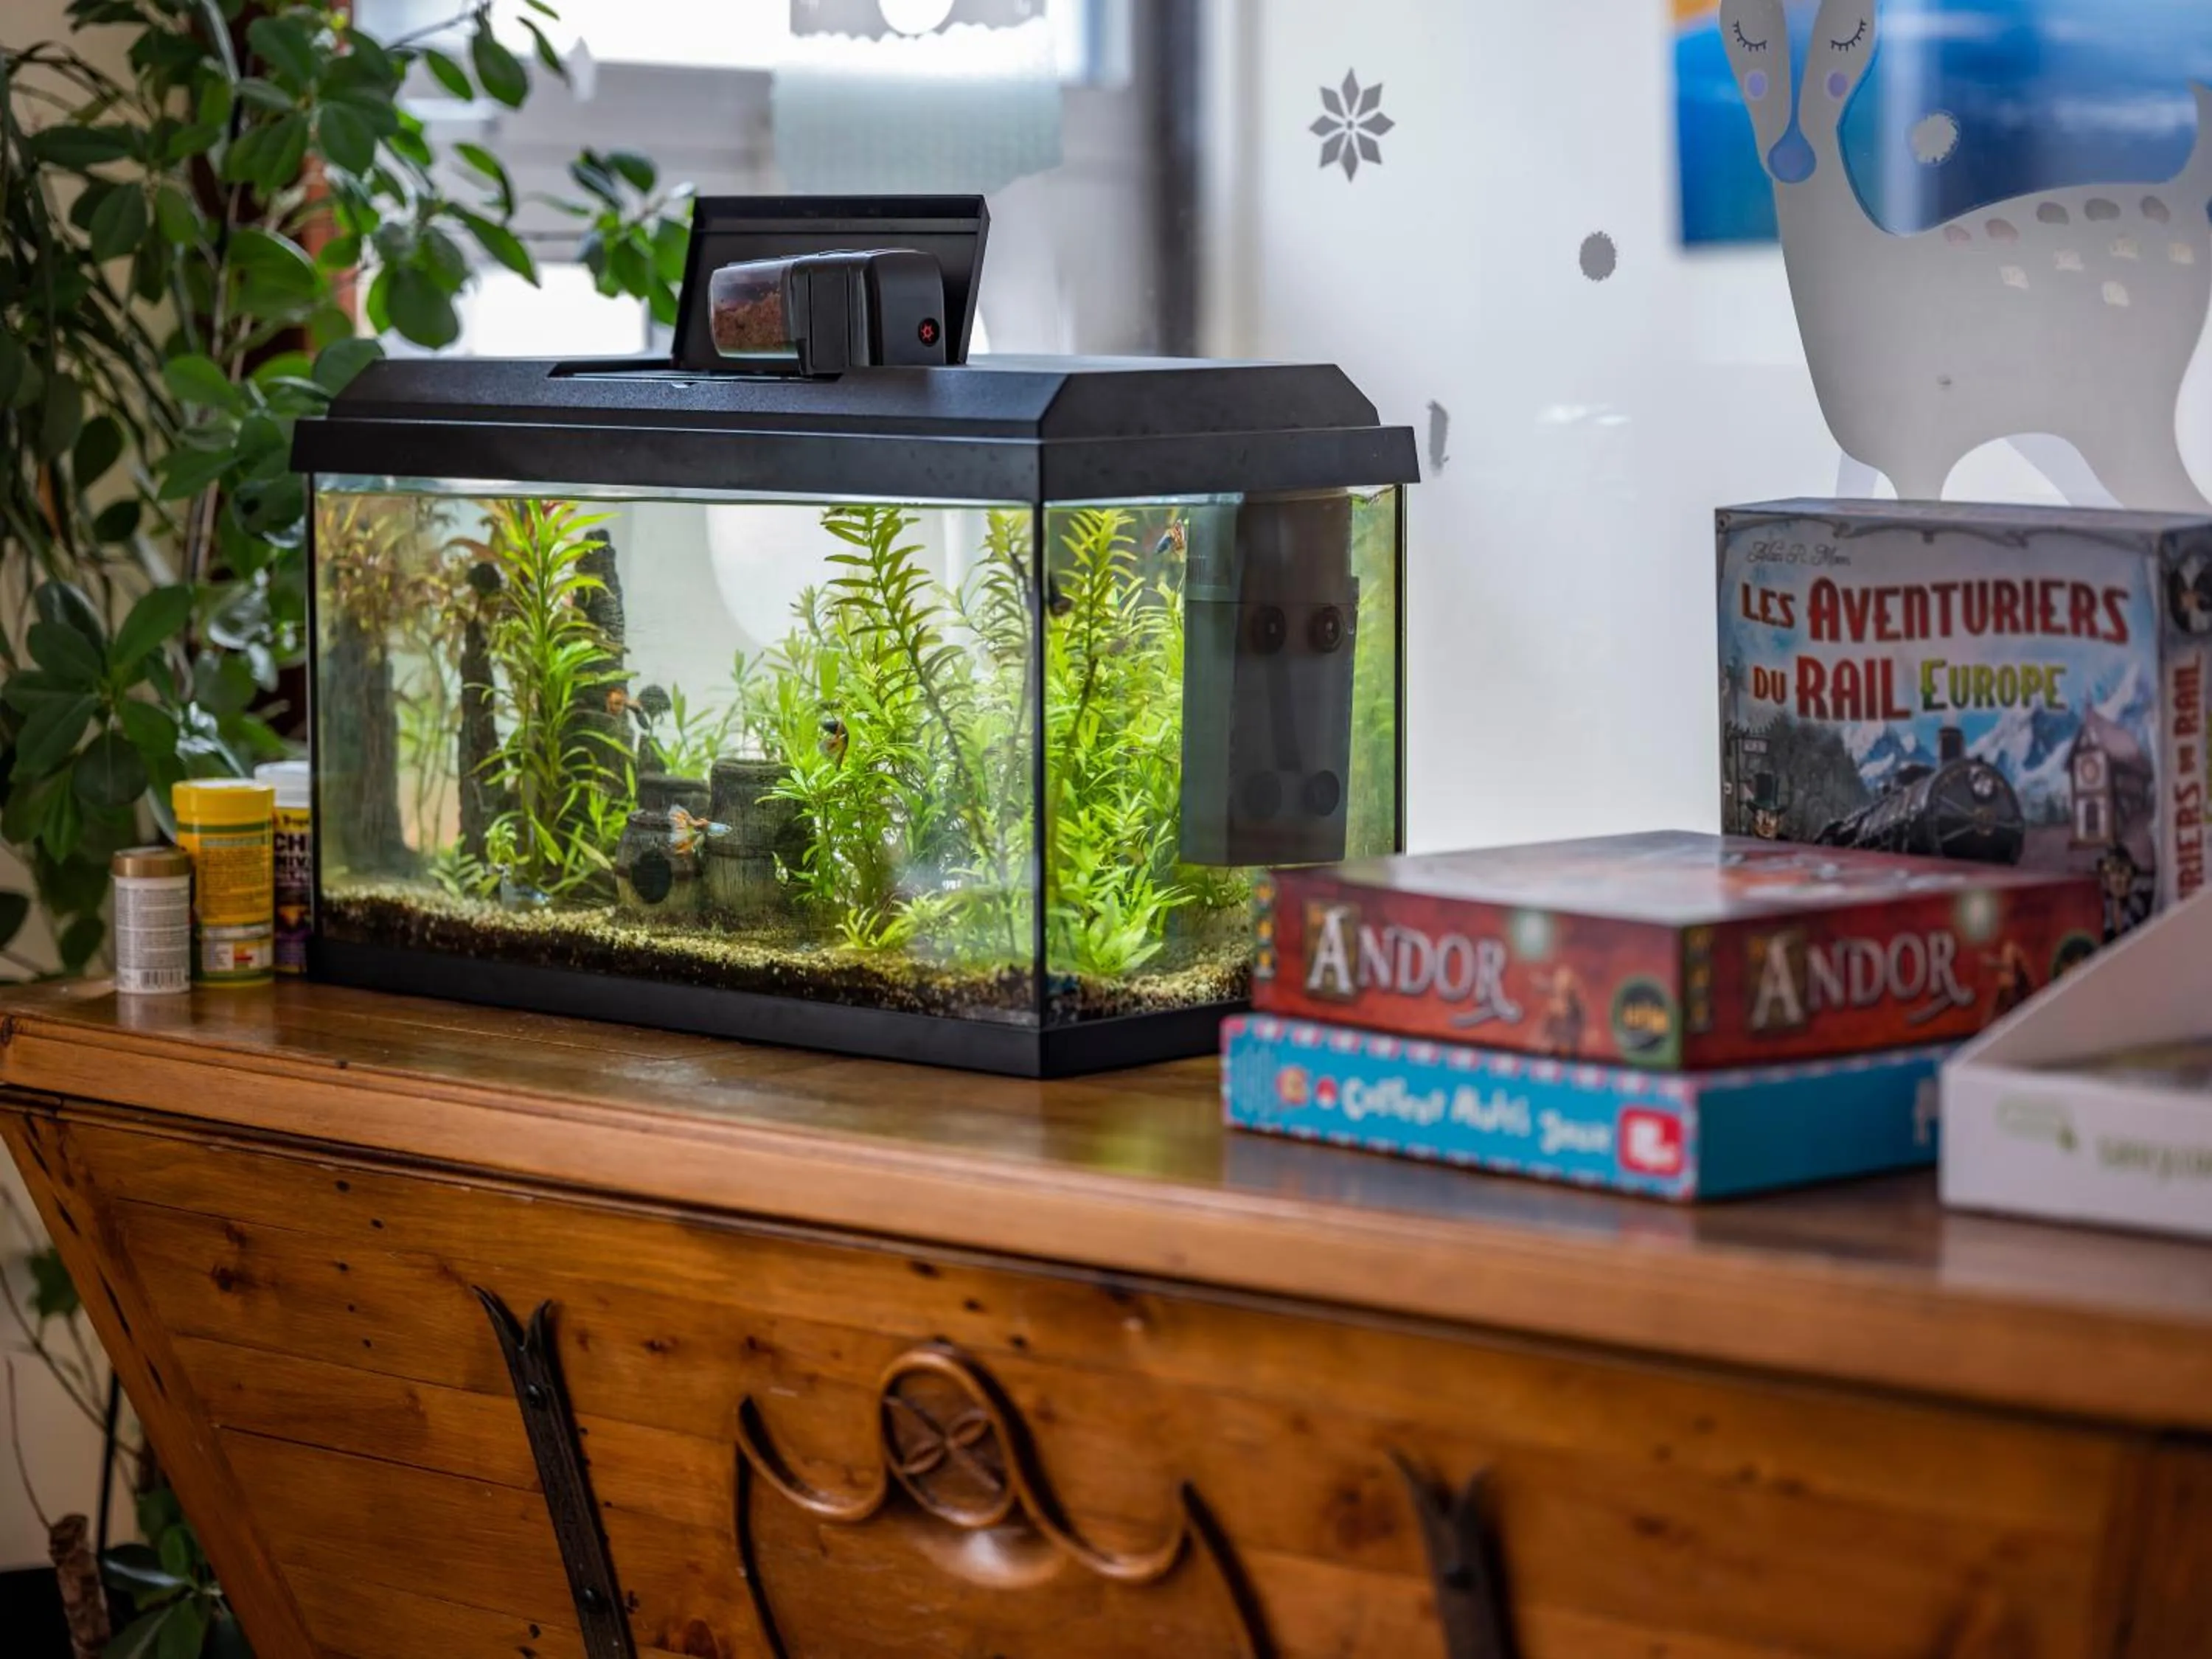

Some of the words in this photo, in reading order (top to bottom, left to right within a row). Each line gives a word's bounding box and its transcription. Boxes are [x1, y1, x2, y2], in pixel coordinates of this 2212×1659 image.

[1742, 582, 1795, 628] LES
[1808, 577, 2129, 644] AVENTURIERS
[1752, 666, 1787, 704] DU
[1795, 655, 1911, 721] RAIL
[2173, 651, 2201, 736] RAIL
[1305, 905, 1523, 1026] ANDOR
[1752, 932, 1974, 1029] ANDOR
